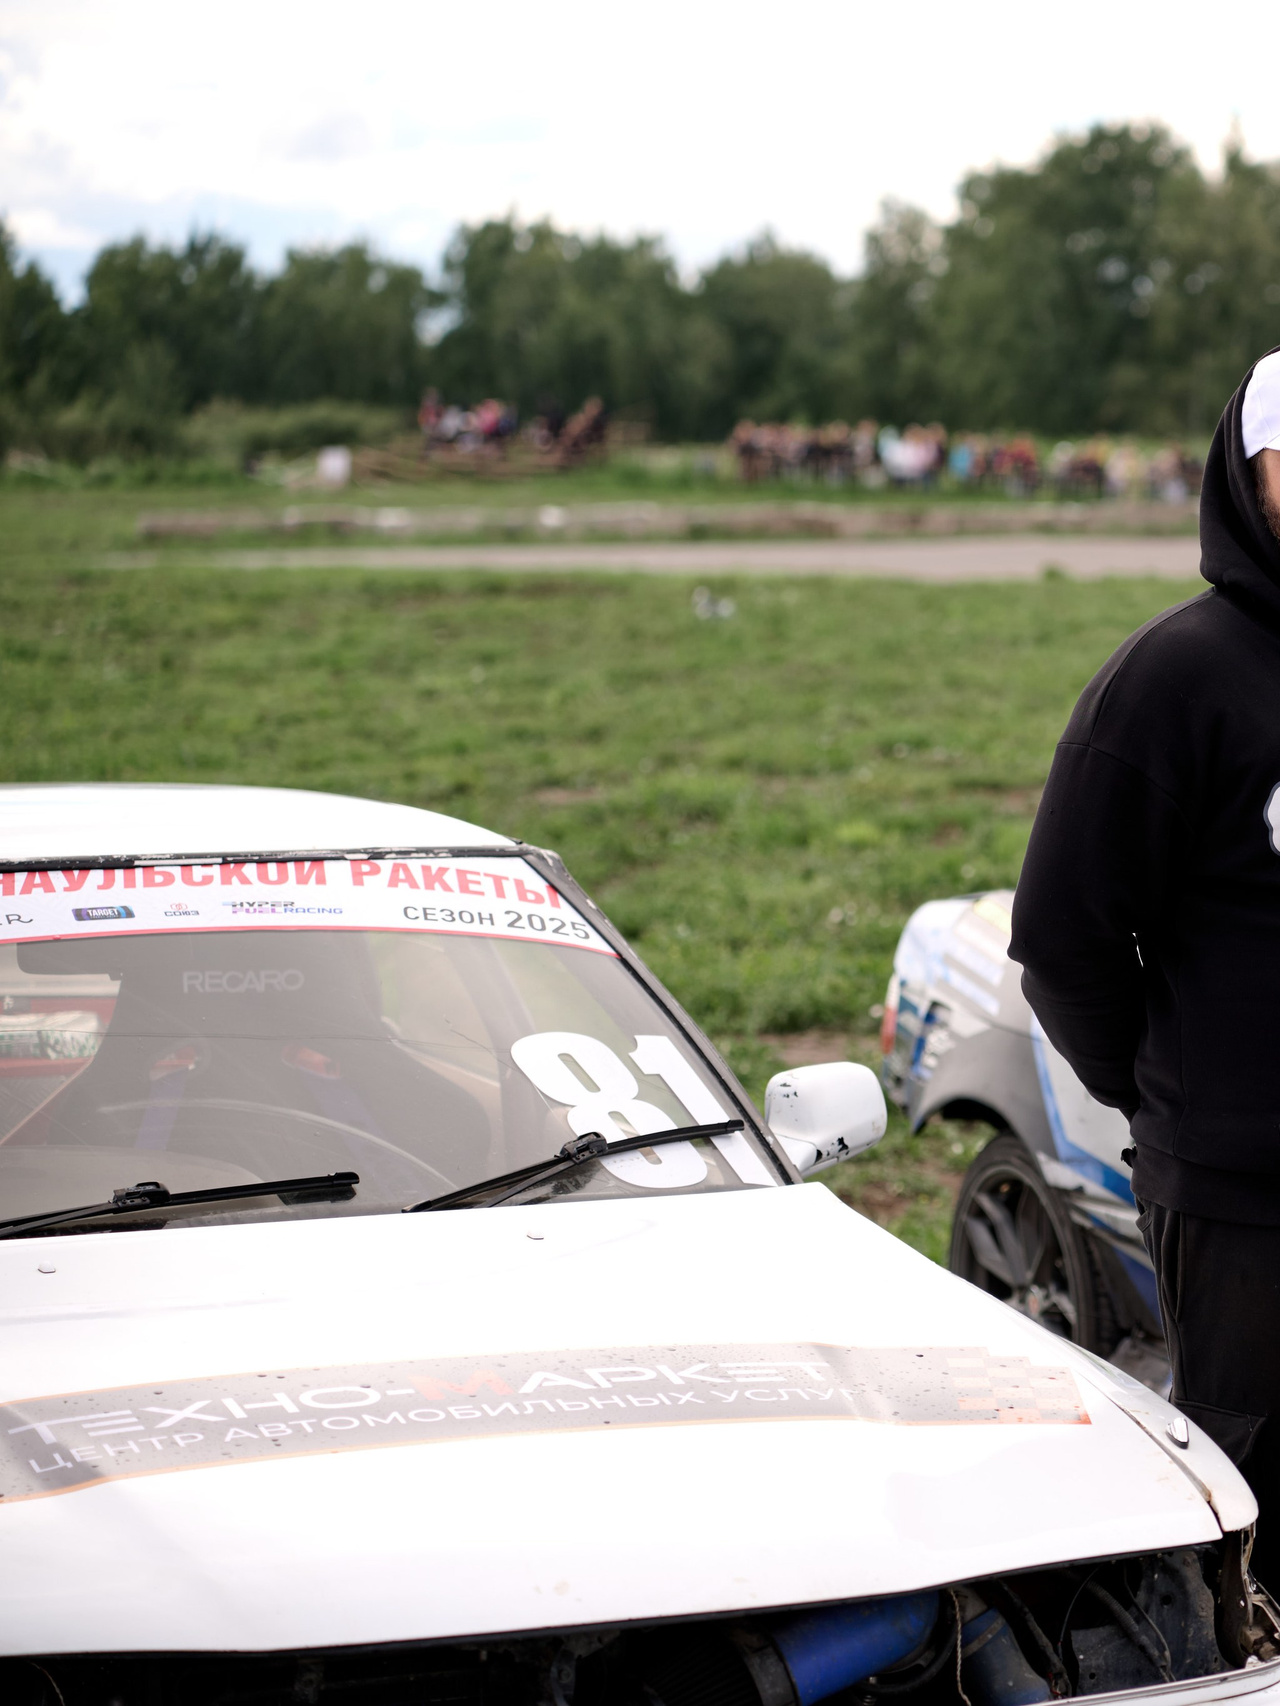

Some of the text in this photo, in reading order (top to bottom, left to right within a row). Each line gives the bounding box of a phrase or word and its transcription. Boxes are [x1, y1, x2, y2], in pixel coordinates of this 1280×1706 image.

[349, 859, 562, 910] РАКЕТЫ
[86, 908, 119, 918] TARGET
[403, 906, 591, 940] СЕЗОН 2025
[183, 969, 304, 995] RECARO
[510, 1031, 781, 1190] 81
[8, 1361, 831, 1446] ТЕХНО-МАРКЕТ
[28, 1430, 204, 1474] ЦЕНТР
[223, 1388, 706, 1442] АВТОМОБИЛЬНЫХ
